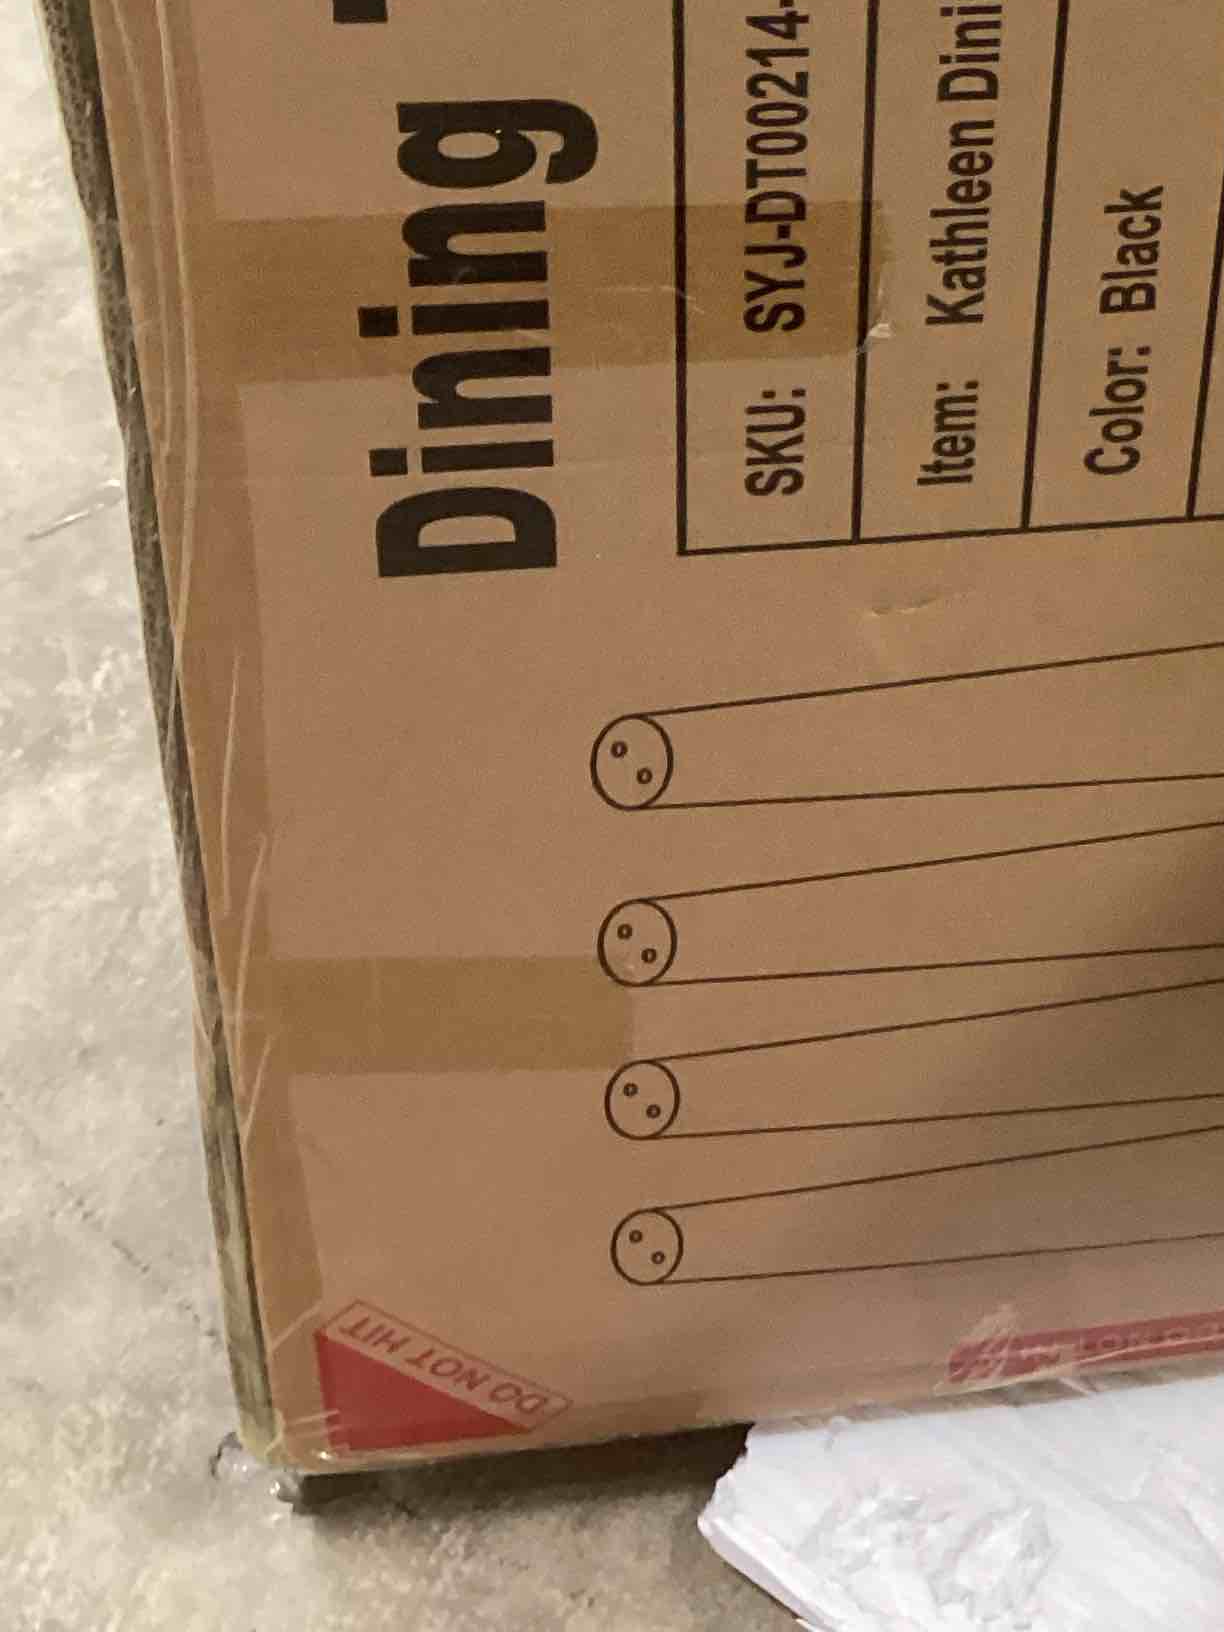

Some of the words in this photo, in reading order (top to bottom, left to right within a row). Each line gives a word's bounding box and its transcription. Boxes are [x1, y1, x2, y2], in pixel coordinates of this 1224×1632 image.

[927, 116, 996, 328] Kathleen
[1100, 184, 1164, 315] Black
[358, 99, 599, 577] Dining
[745, 388, 806, 497] SKU:
[917, 380, 980, 487] Item:
[1084, 344, 1153, 477] Color:
[339, 1317, 412, 1354] HIT
[405, 1349, 491, 1392] NOT
[490, 1382, 547, 1416] DO
